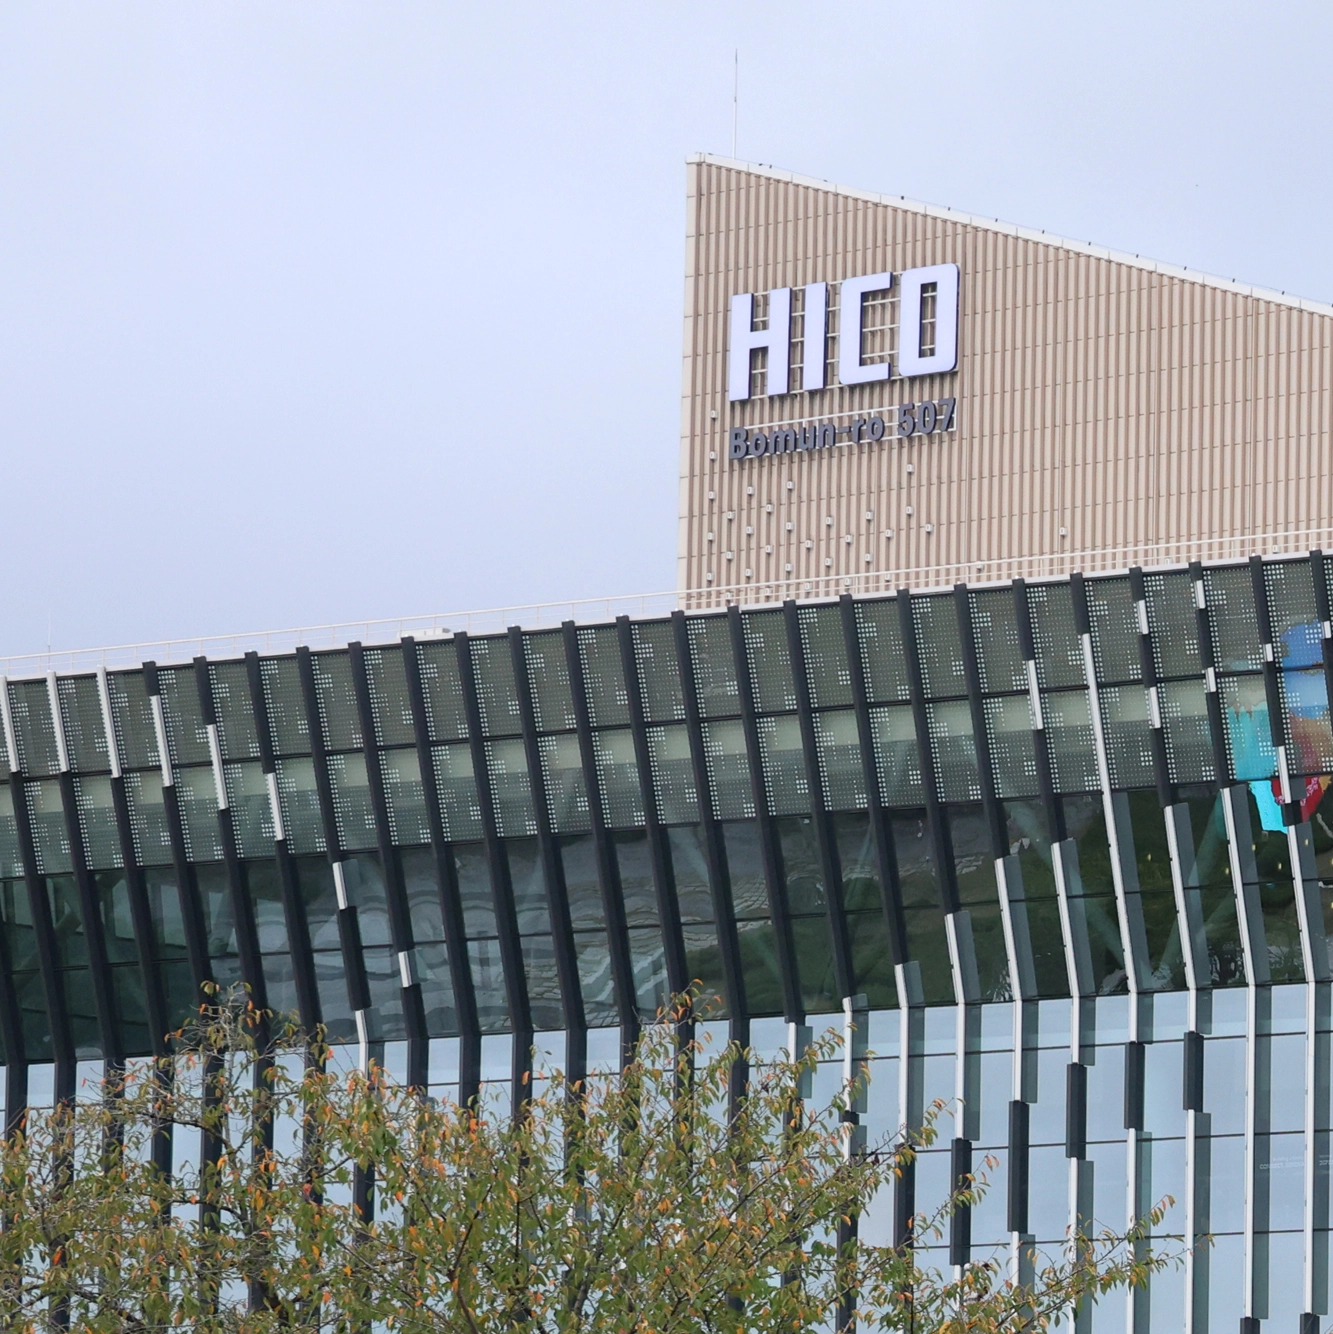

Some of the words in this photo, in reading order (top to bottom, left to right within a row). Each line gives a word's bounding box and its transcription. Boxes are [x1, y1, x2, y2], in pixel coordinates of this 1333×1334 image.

[729, 263, 959, 401] HICO
[729, 414, 884, 460] Bomun-ro
[898, 397, 956, 438] 507
